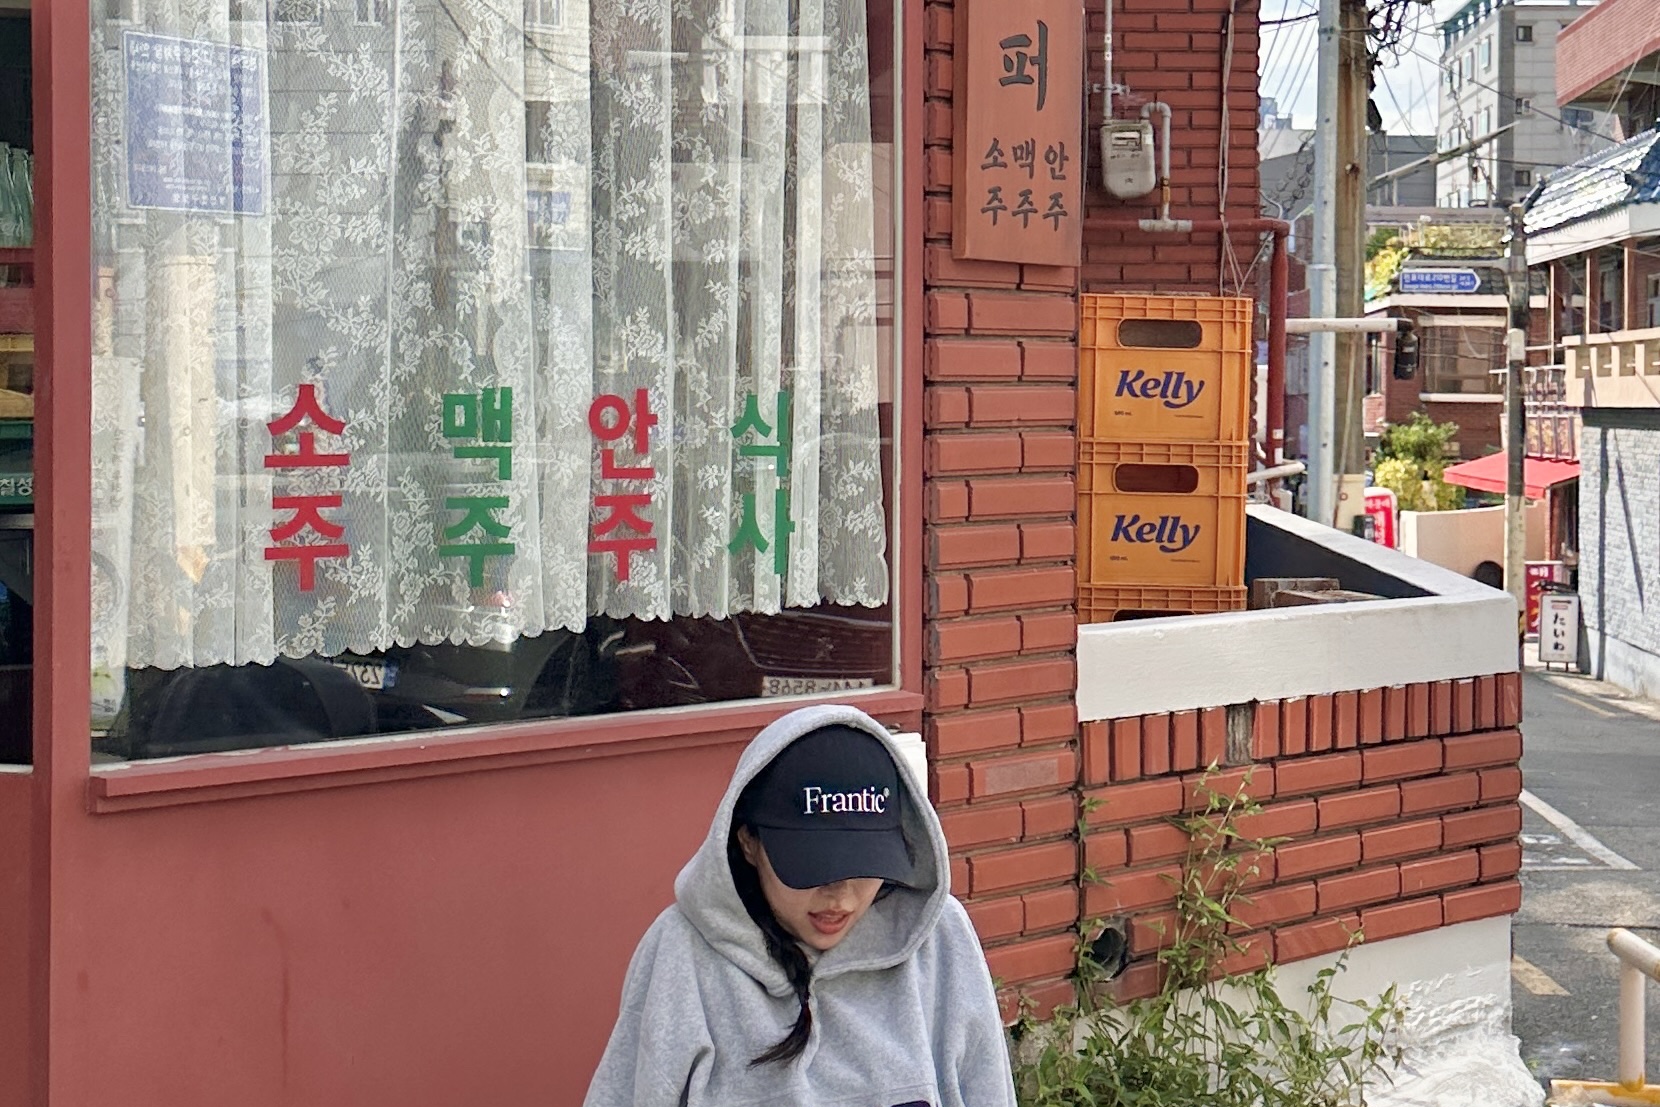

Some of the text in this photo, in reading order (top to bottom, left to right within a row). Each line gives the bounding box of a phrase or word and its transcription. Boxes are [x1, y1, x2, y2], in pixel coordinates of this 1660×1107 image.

[999, 19, 1048, 112] 퍼
[980, 137, 1008, 227] 소주
[1011, 137, 1038, 229] 맥주
[1042, 141, 1069, 232] 안주
[1115, 369, 1205, 409] Kelly
[264, 384, 350, 592] 소주
[438, 386, 516, 588] 맥주
[587, 388, 659, 582] 안주
[727, 391, 796, 575] 식사
[1110, 514, 1201, 553] Kelly
